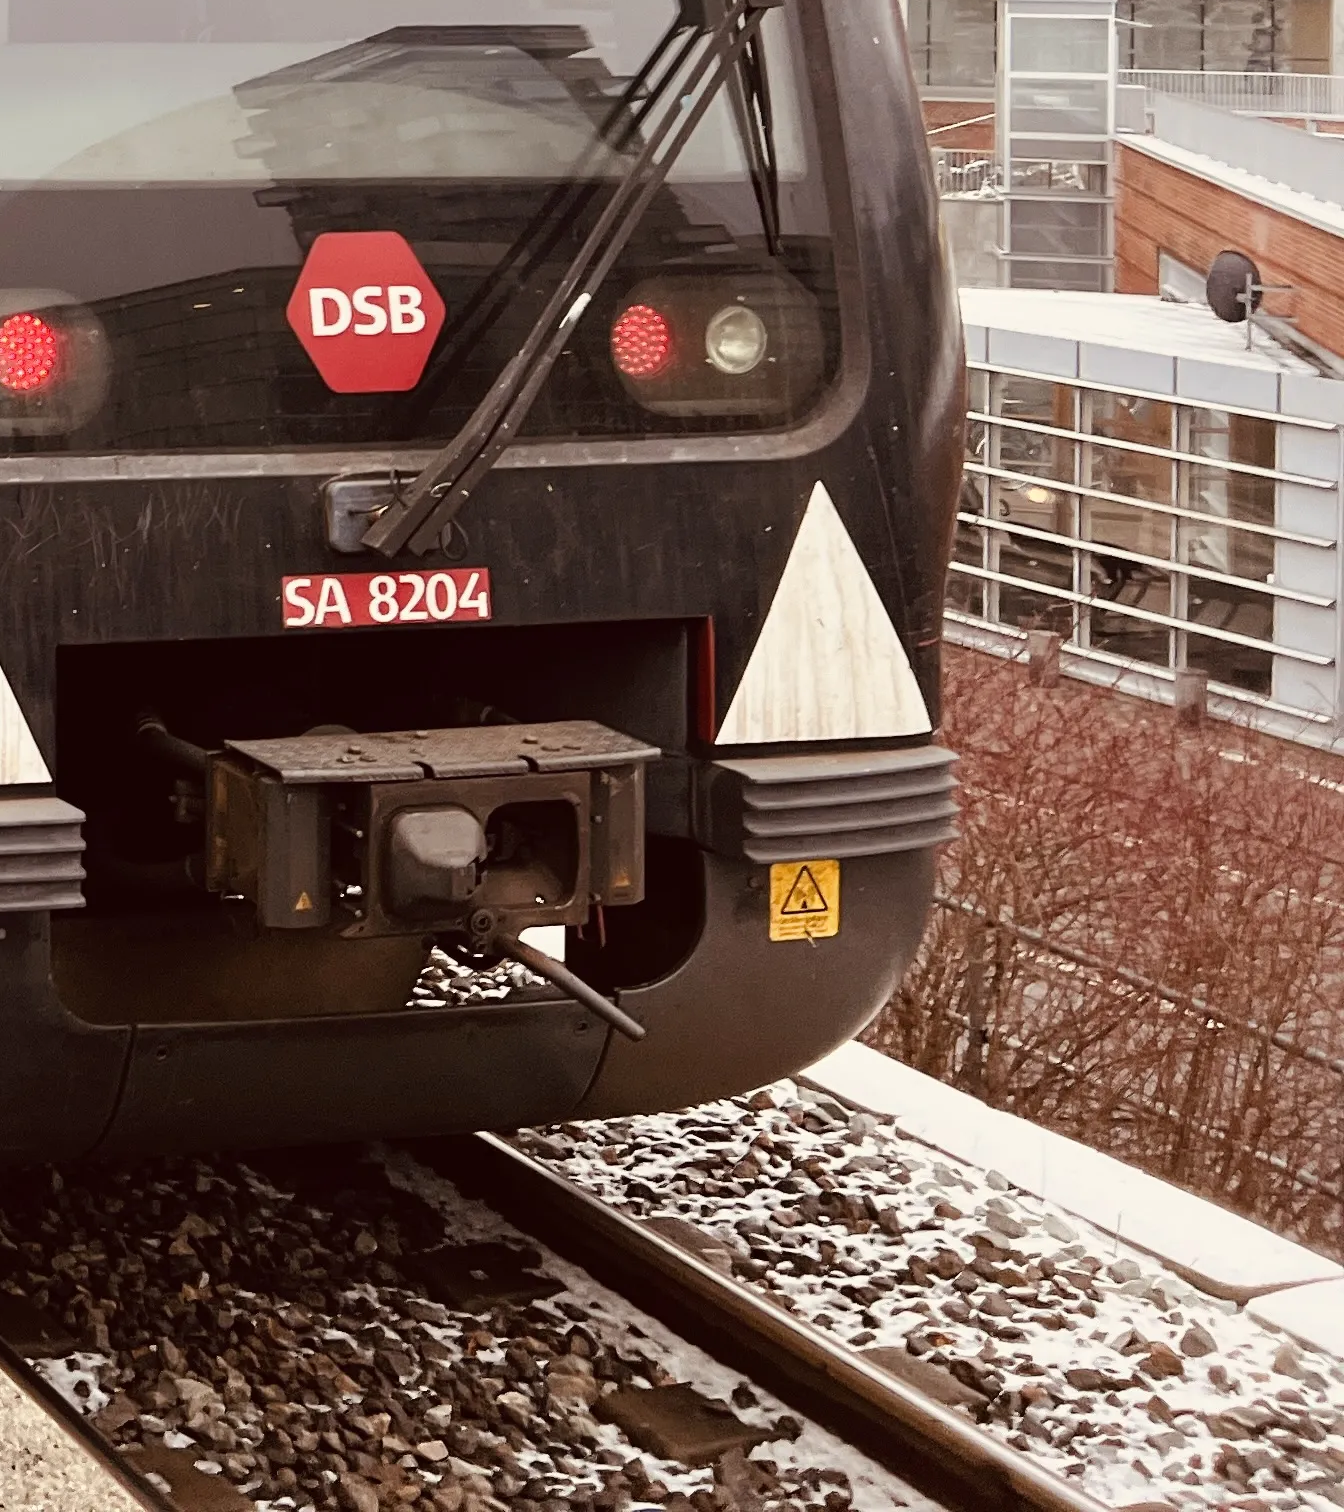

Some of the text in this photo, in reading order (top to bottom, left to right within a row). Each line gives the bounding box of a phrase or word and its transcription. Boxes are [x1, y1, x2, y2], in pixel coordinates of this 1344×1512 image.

[308, 285, 426, 337] DSB
[284, 572, 489, 627] SA 8204
